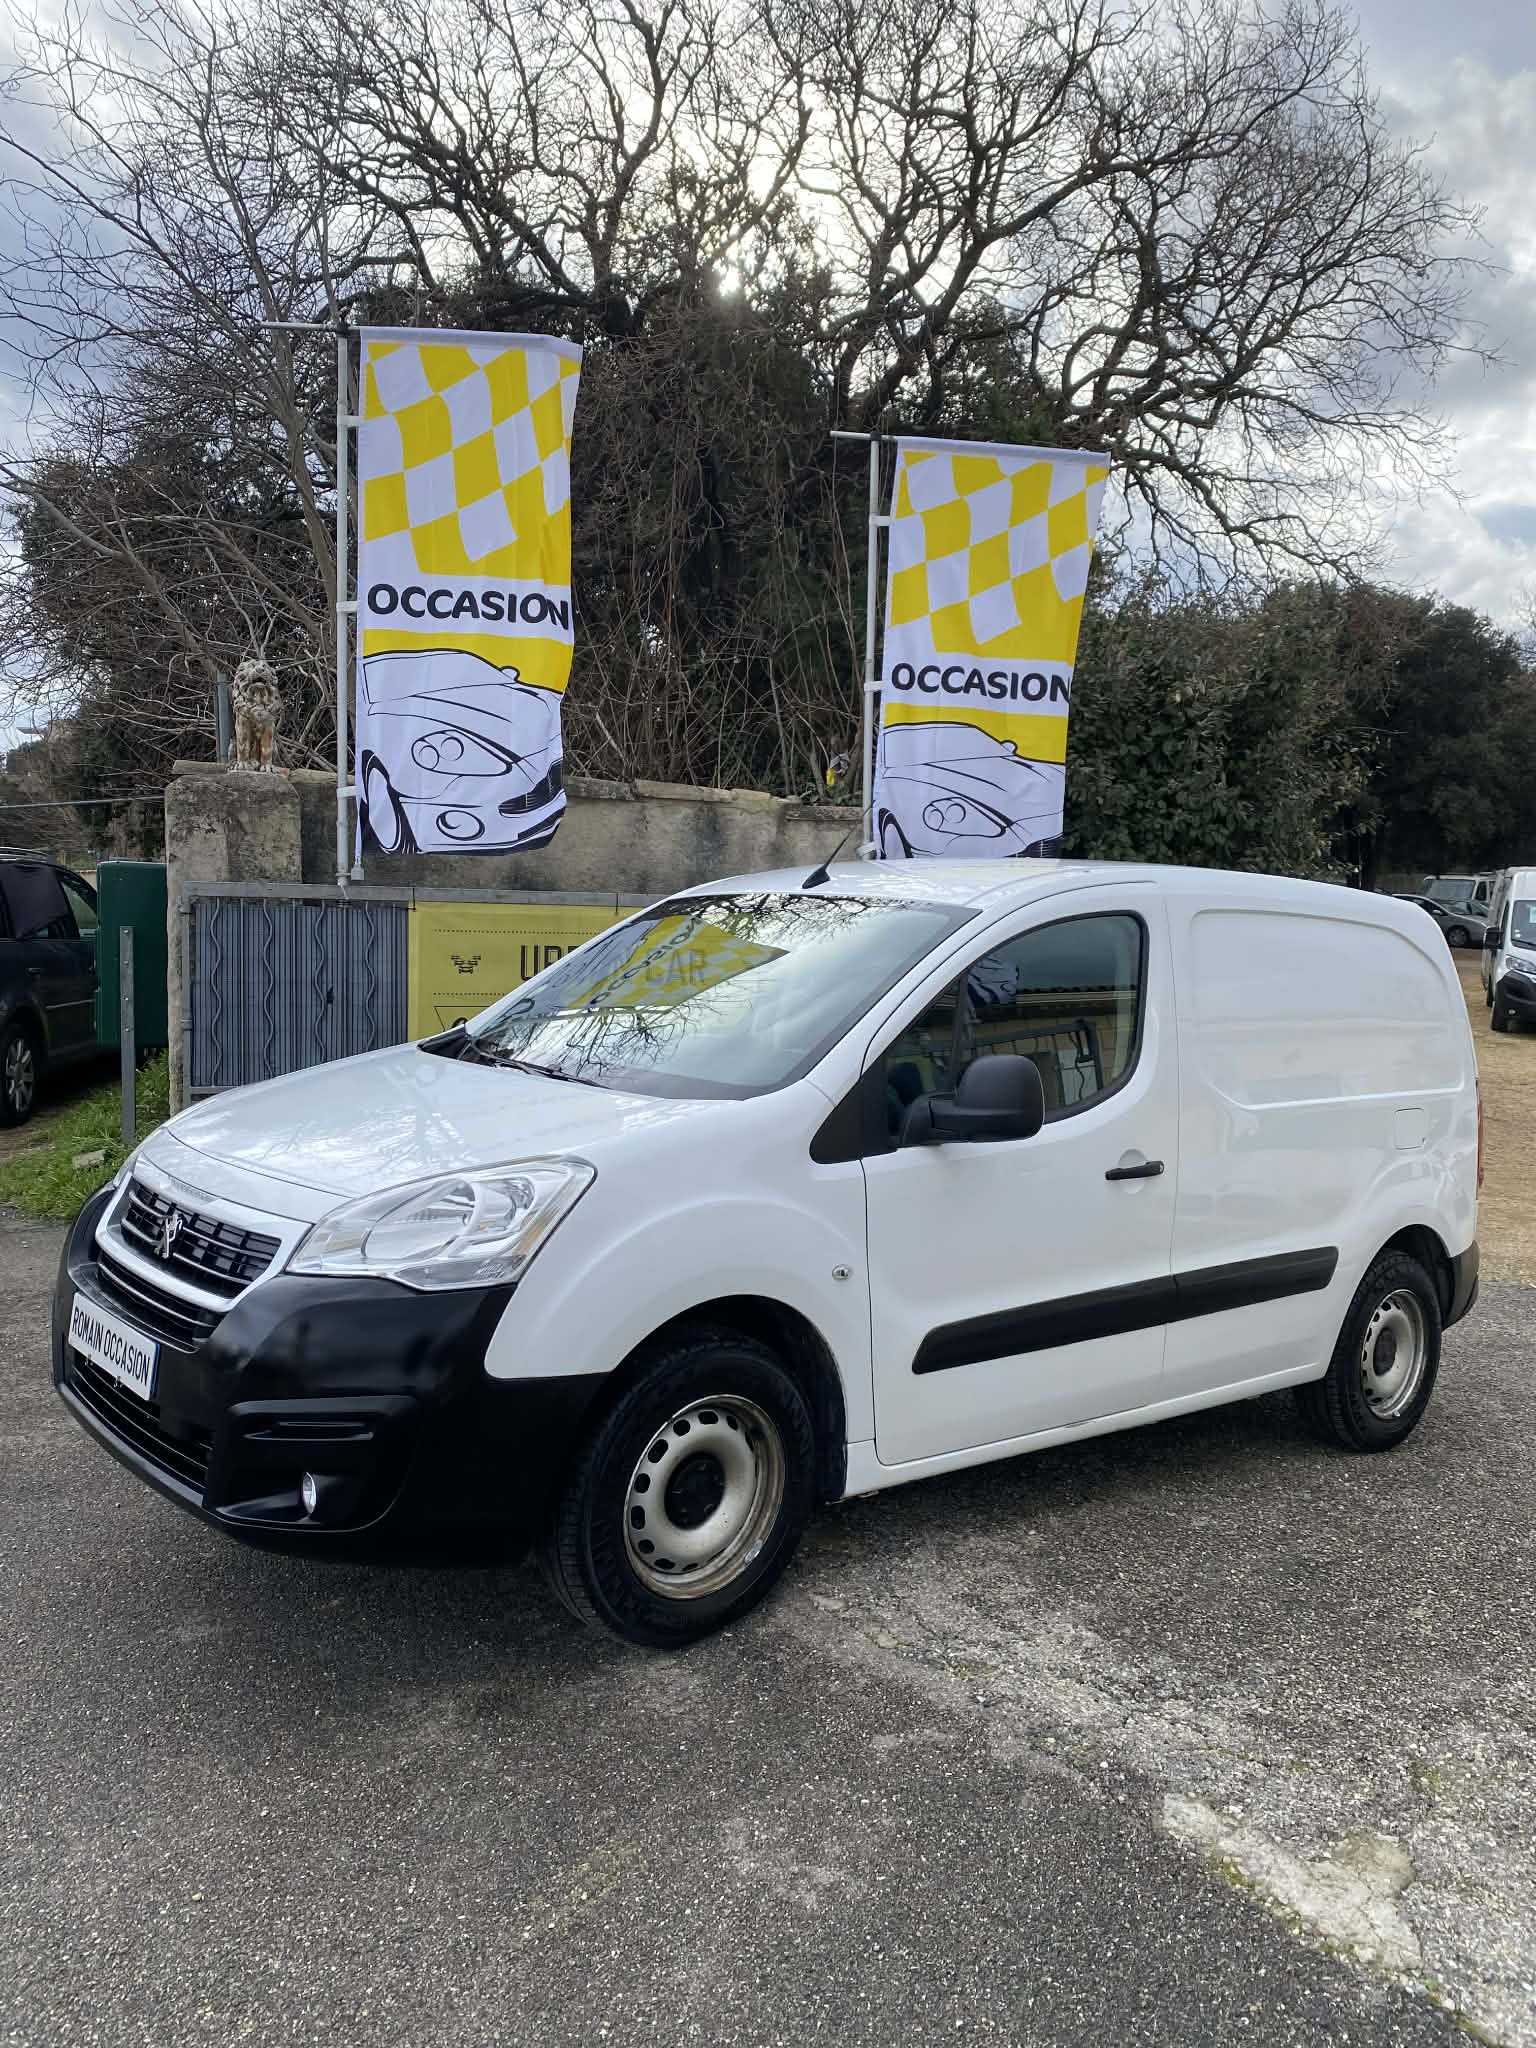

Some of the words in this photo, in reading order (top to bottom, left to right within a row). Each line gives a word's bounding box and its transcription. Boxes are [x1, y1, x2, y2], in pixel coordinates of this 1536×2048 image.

[367, 583, 570, 631] OCCASION
[891, 663, 1072, 704] OCCASION
[72, 1306, 104, 1353] ROMAIN
[104, 1329, 150, 1387] OCCASION
